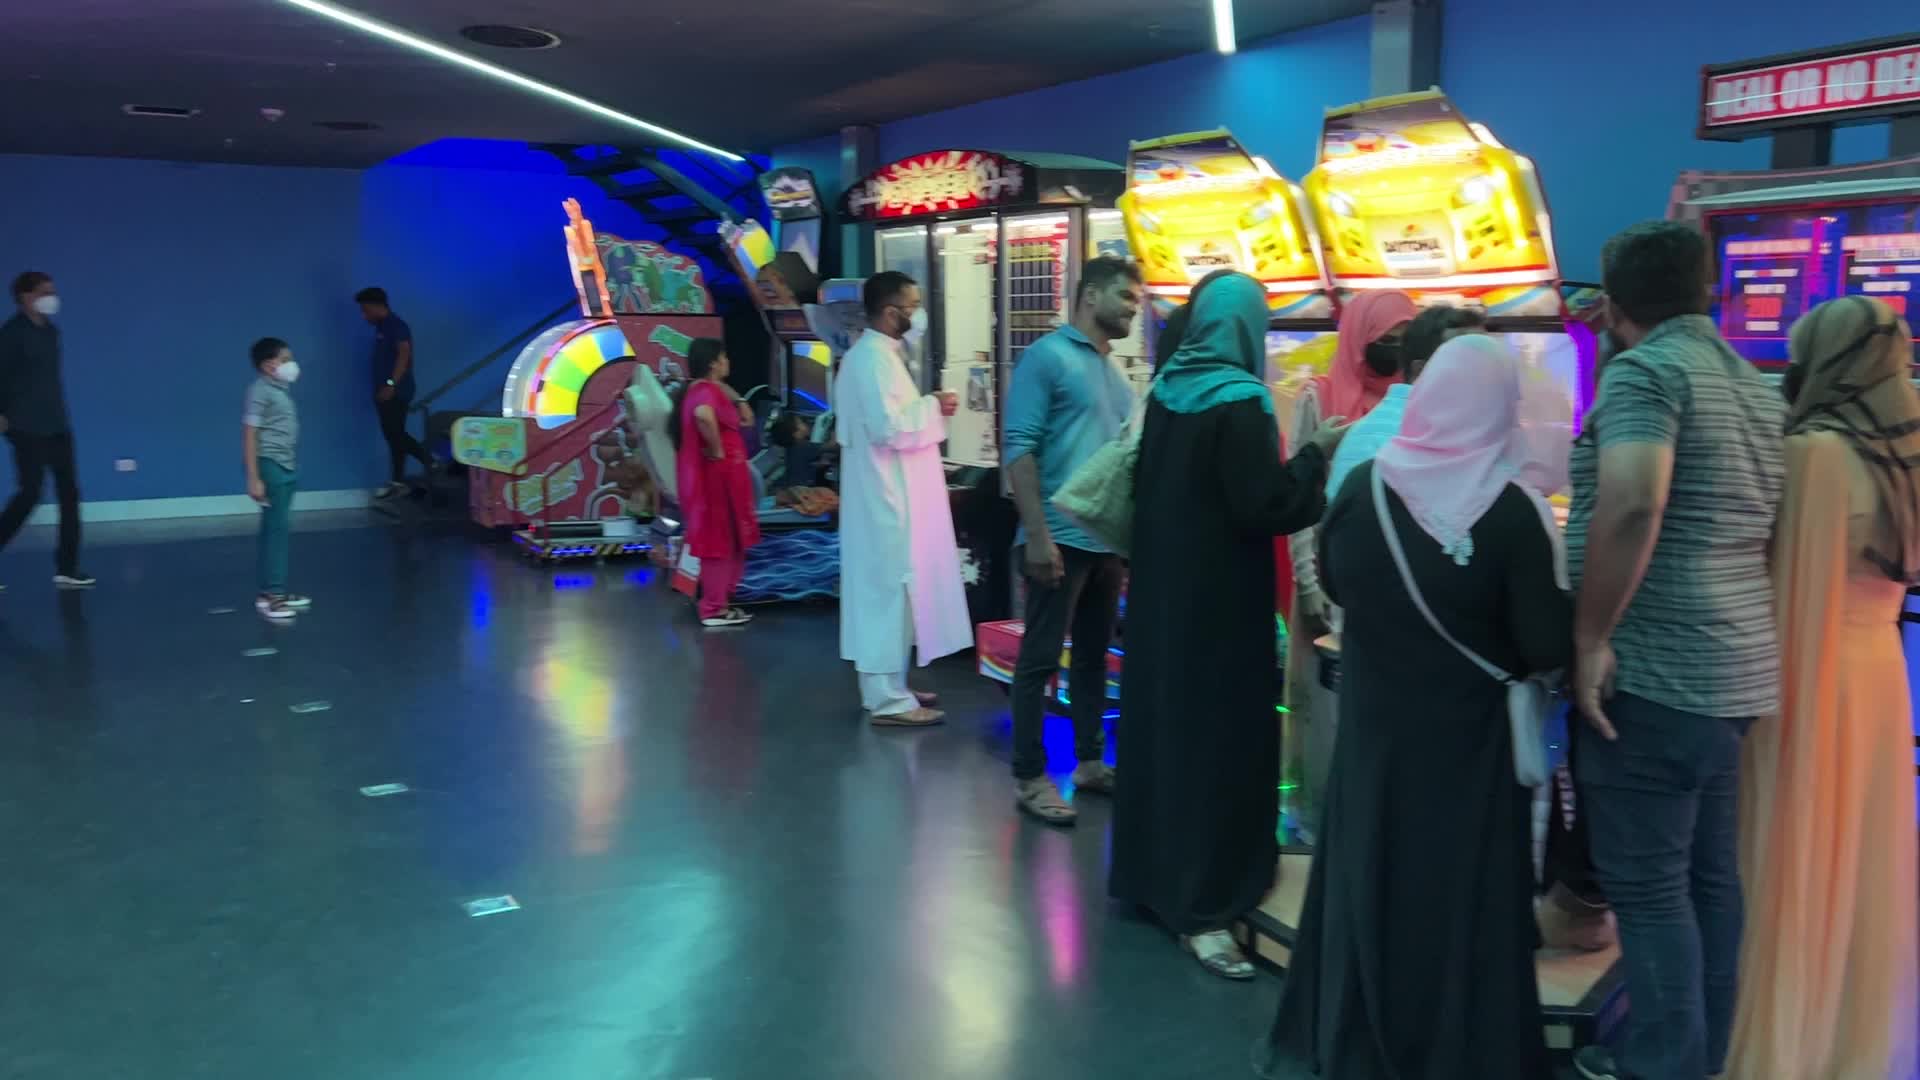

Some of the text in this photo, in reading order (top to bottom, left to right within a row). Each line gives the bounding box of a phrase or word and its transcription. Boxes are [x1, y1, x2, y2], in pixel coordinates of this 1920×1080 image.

[1713, 75, 1777, 118] DEAL
[1780, 68, 1822, 109] OR
[1824, 60, 1870, 104] NO
